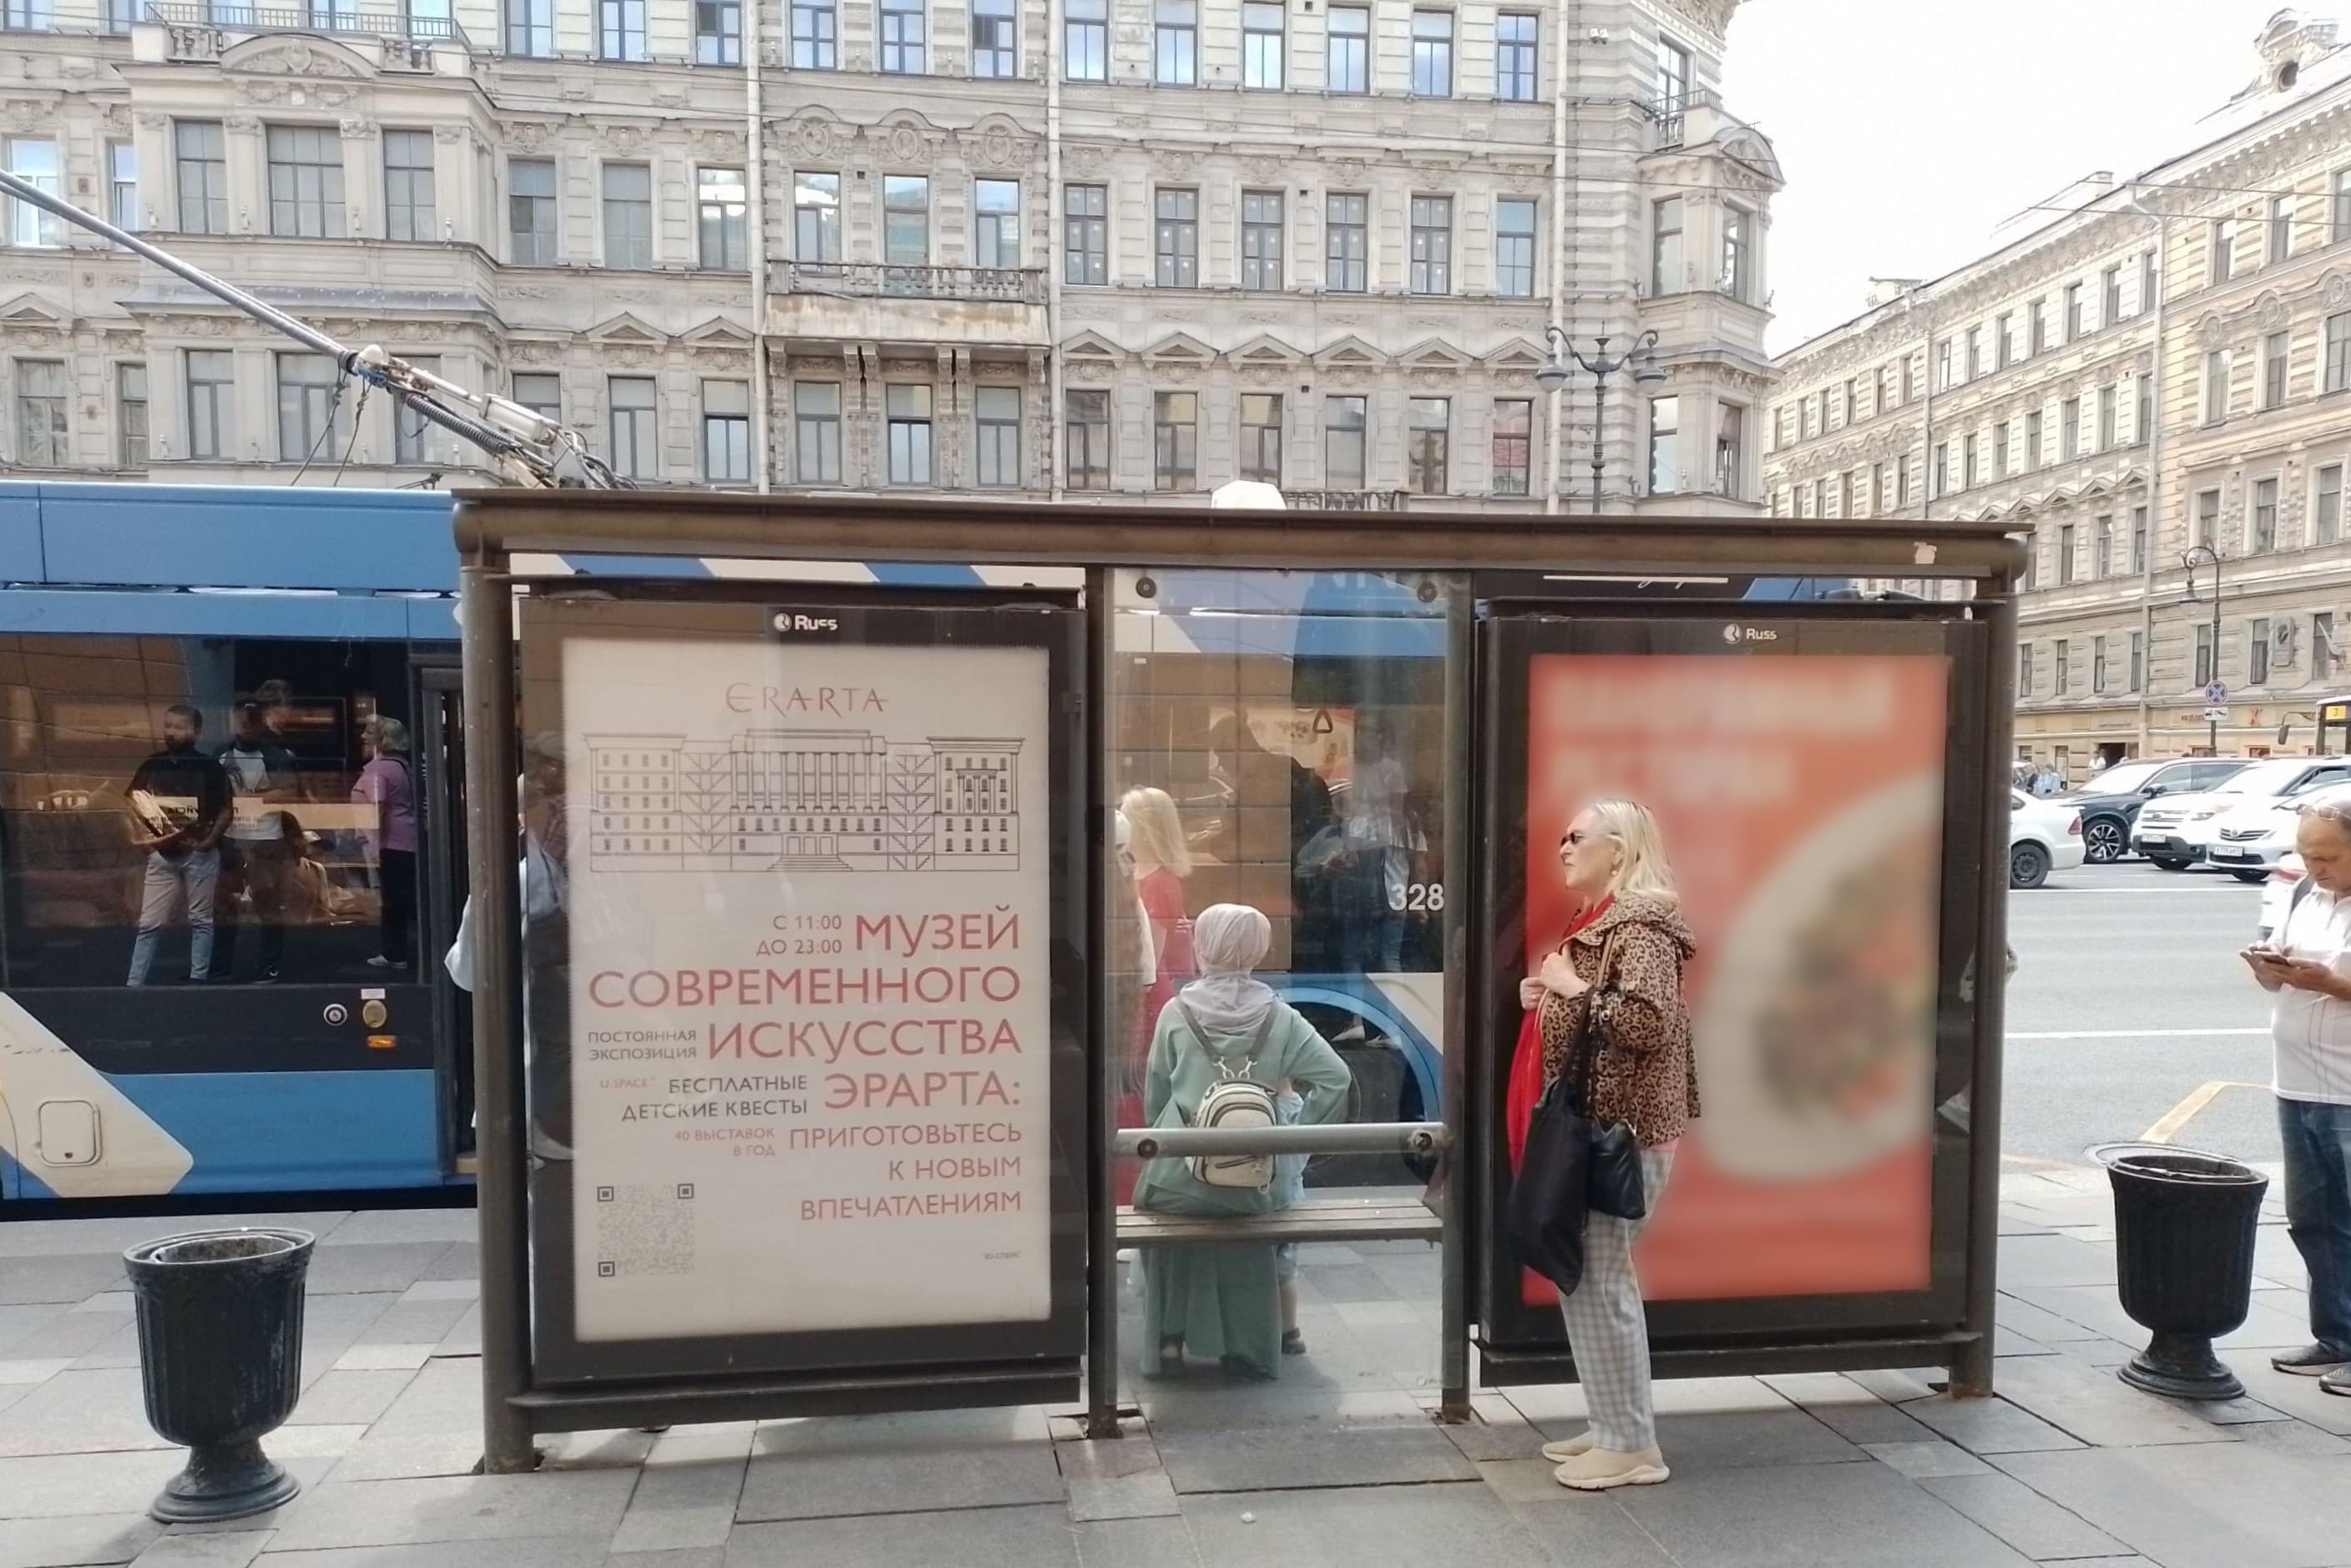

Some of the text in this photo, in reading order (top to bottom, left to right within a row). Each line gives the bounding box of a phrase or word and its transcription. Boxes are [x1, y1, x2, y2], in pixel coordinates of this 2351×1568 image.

[794, 614, 838, 631] Russ
[1746, 627, 1777, 640] Russ
[726, 683, 888, 718] ERARTA
[1389, 883, 1444, 911] 328
[772, 914, 842, 931] С 11:00
[856, 904, 1019, 959] МУЗЕЙ
[756, 938, 842, 957] ДО 23:00
[589, 965, 1020, 1009] СОВРЕМЕННОГО
[588, 1029, 697, 1044] ПОСТОЯННАЯ
[709, 1018, 1022, 1065] ИСКУССТВА
[589, 1046, 697, 1061] ЭКСПОЗИЦИЯ
[669, 1075, 807, 1095] БЕСПЛАТНЫЕ
[824, 1070, 1020, 1110] ЭРАРТА:
[621, 1099, 807, 1122] ДЕТСКИЕ КВЕСТЫ
[674, 1126, 776, 1142] 40 ВЫСТАВОК
[790, 1122, 1022, 1150] ПРИГОТОВЬТЕСЬ
[733, 1144, 776, 1158] В ГОД
[889, 1156, 1021, 1181] К НОВЫМ
[801, 1191, 1021, 1221] ВПЕЧАТЛЕНИЯМ
